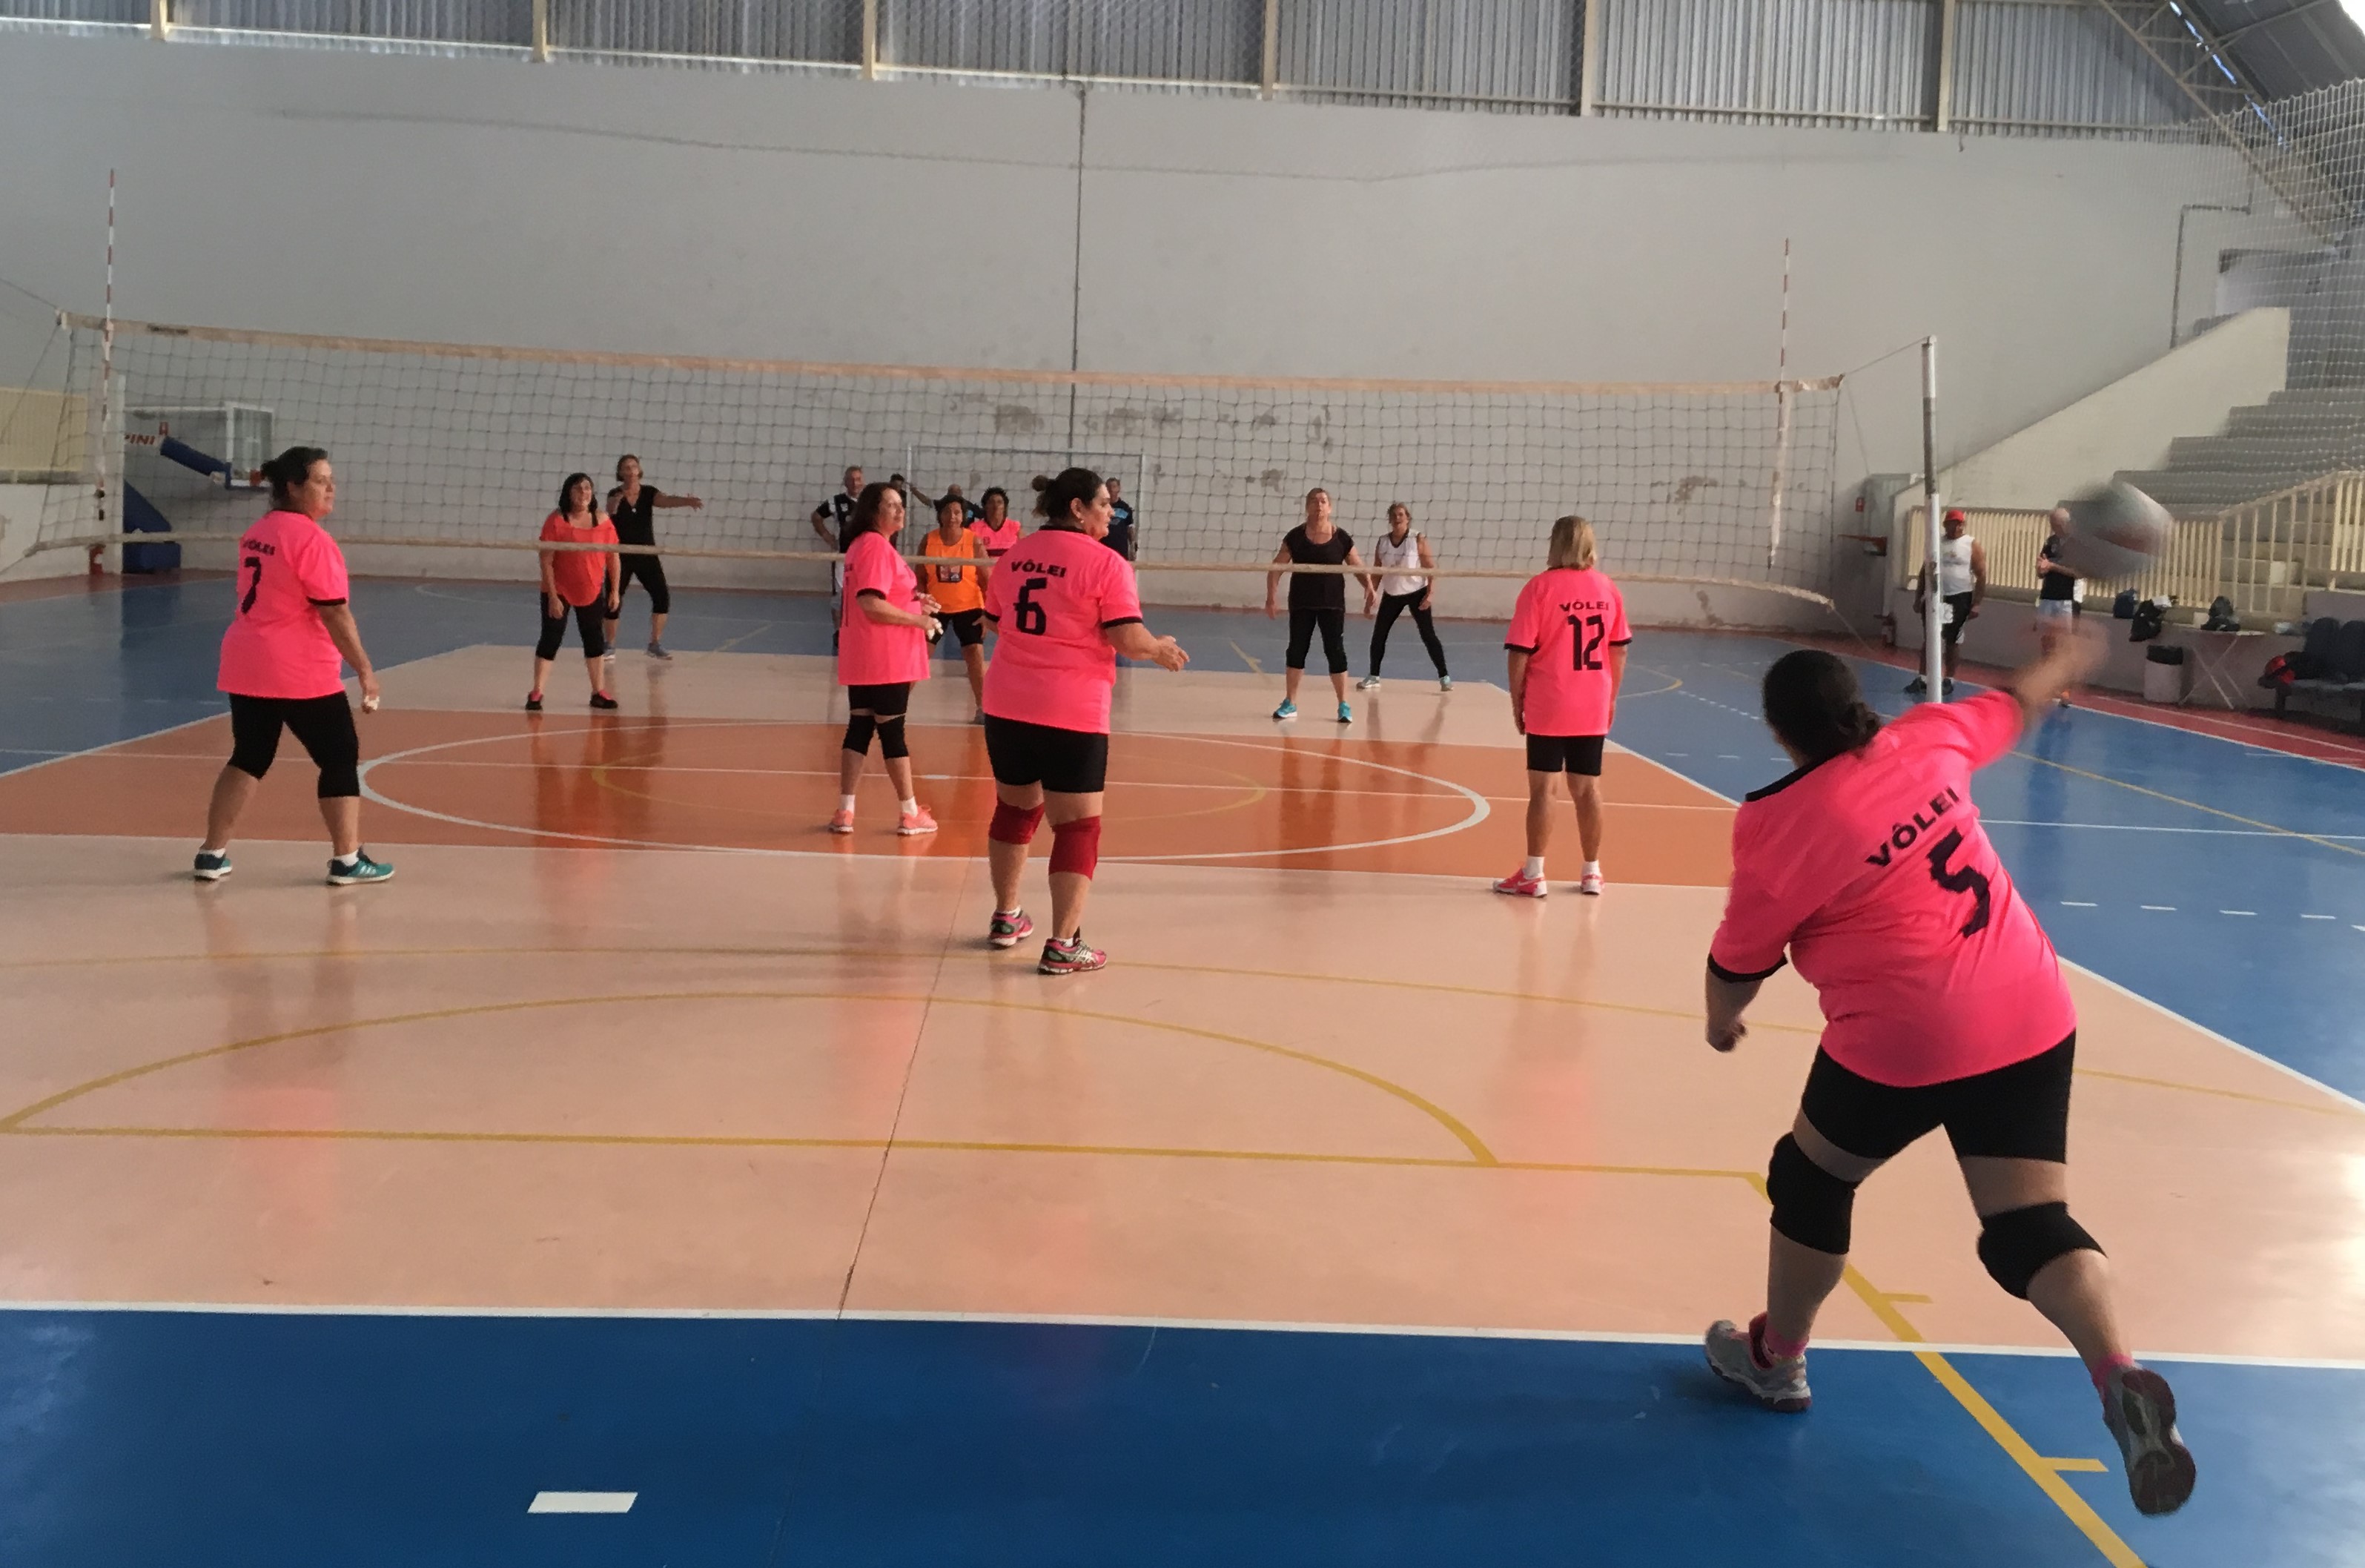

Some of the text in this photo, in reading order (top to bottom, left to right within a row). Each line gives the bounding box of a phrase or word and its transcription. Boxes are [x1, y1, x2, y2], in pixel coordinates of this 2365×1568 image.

[241, 557, 262, 615] 7
[1010, 558, 1067, 578] VÔLEI
[1013, 578, 1047, 635] 6
[1559, 599, 1609, 612] VÔLEI
[1567, 614, 1604, 671] 12
[1864, 786, 1960, 867] VÔLEI
[1925, 825, 1990, 939] 5
